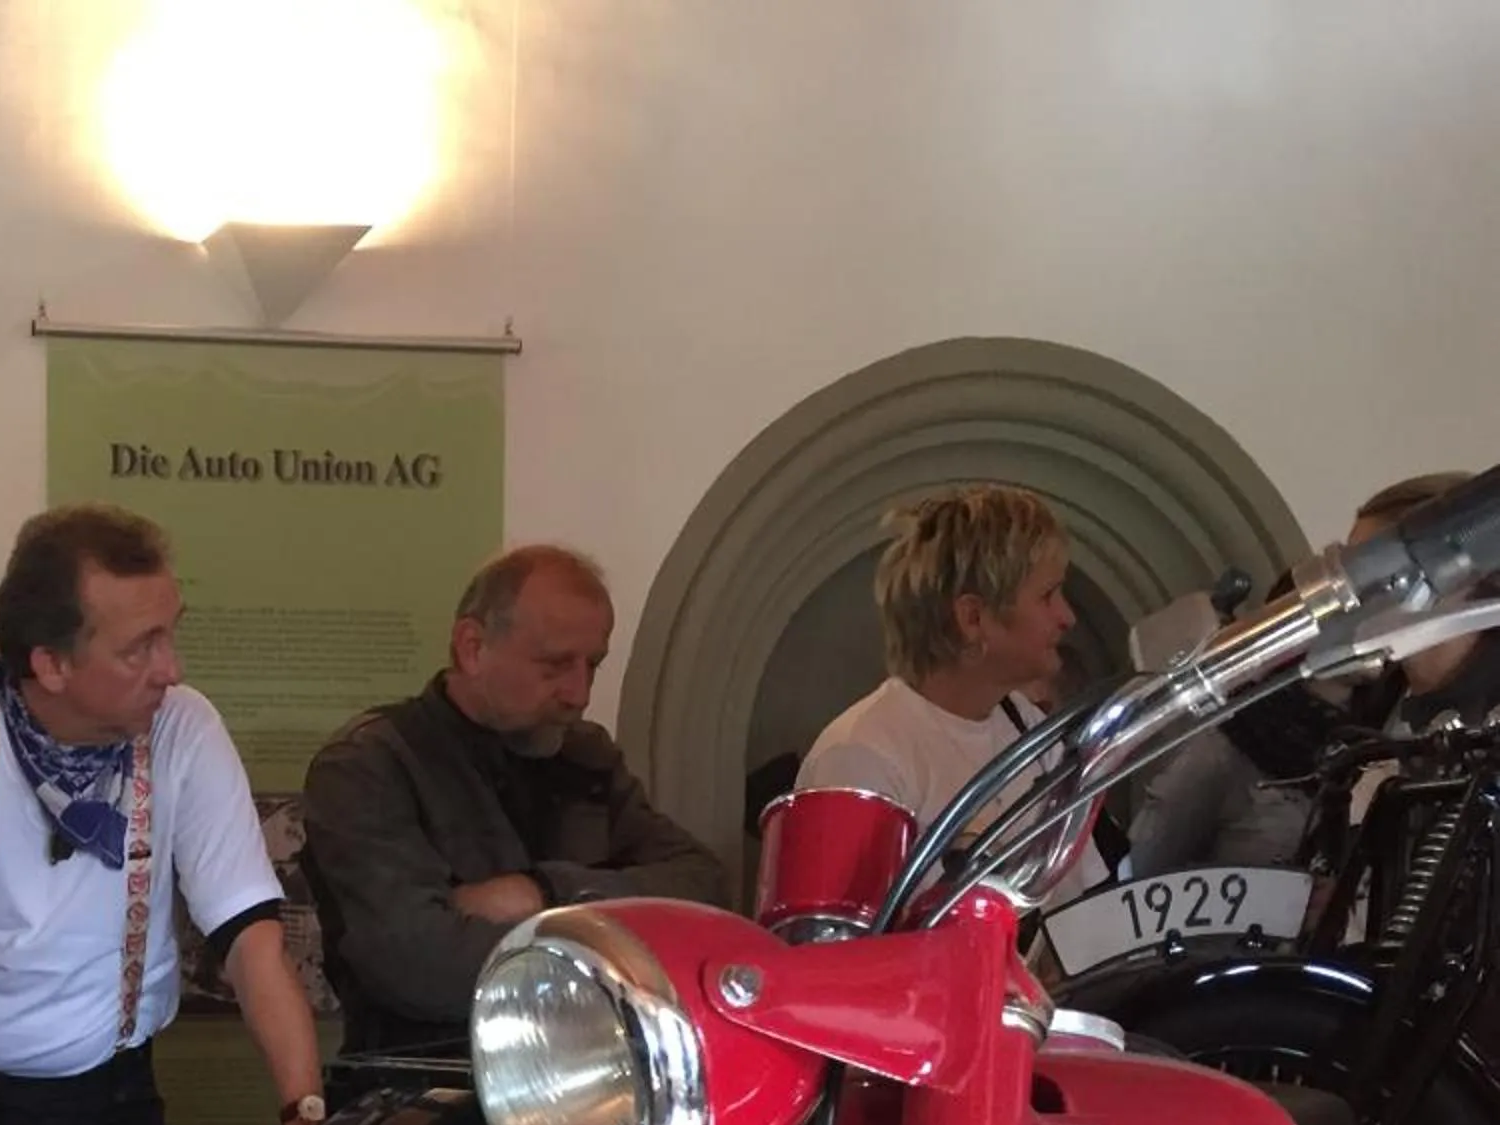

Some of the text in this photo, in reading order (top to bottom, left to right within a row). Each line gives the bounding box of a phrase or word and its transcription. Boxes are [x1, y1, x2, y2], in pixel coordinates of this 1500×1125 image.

[110, 443, 443, 488] Die Auto Union AG
[1121, 873, 1248, 939] 1929
